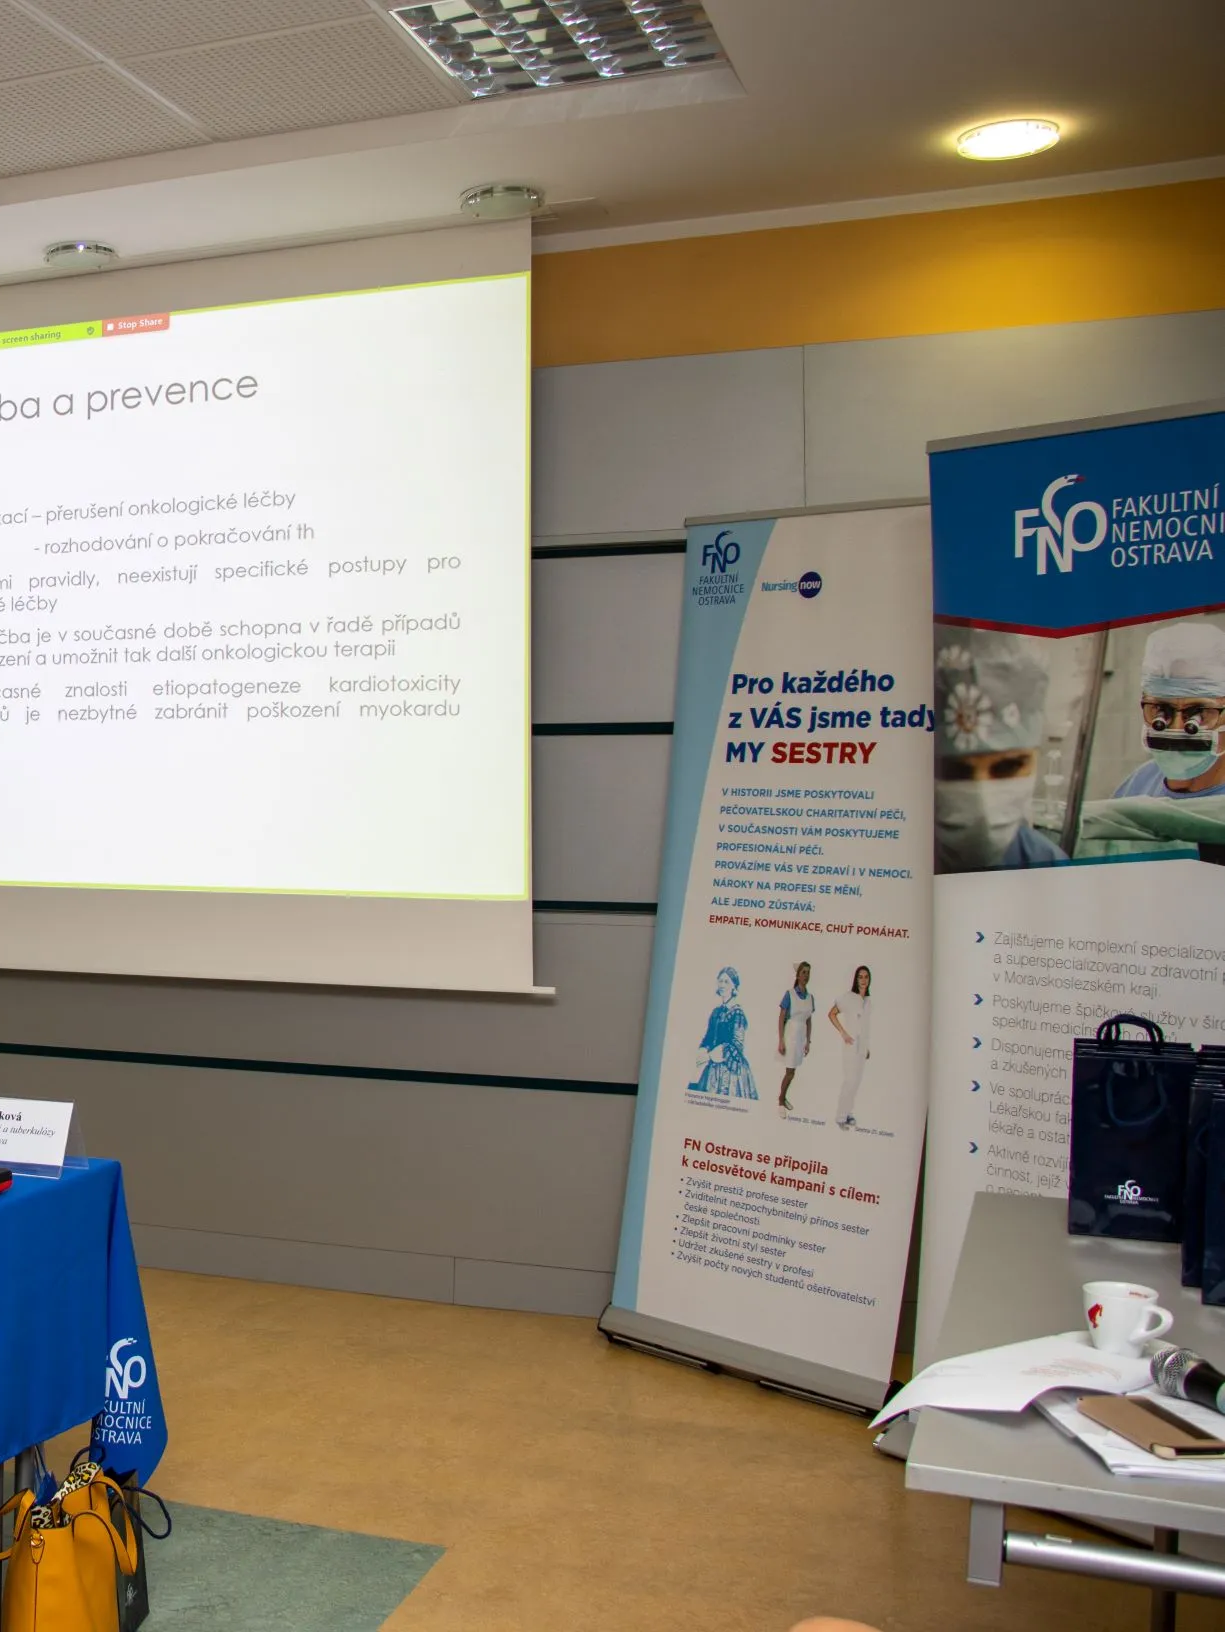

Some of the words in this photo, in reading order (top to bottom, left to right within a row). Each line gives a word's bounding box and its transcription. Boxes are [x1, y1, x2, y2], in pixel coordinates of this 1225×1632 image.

[117, 320, 138, 330] Stop
[138, 318, 163, 327] Share
[0, 334, 29, 345] screen
[29, 329, 62, 341] sharing
[52, 393, 74, 416] a
[86, 375, 259, 420] prevence
[45, 500, 125, 525] přerušení
[127, 493, 238, 516] onkologické
[242, 489, 296, 510] léčby
[1112, 482, 1220, 519] FAKULTNÍ
[43, 532, 154, 554] rozhodování
[156, 535, 169, 548] o
[173, 523, 293, 550] pokračování
[296, 522, 315, 540] th
[1111, 512, 1225, 543] NEMOCNI
[1110, 539, 1214, 568] OSTRAVA
[28, 569, 100, 592] pravidly,
[117, 563, 199, 584] neexistují
[214, 558, 309, 582] specifické
[327, 555, 408, 578] postupy
[426, 555, 462, 574] pro
[698, 571, 739, 585] FAKULTNÍ
[692, 583, 745, 596] NEMOCNICE
[761, 579, 798, 593] Nursing
[799, 580, 822, 590] now
[10, 594, 58, 613] léčby
[698, 594, 736, 606] OSTRAVA
[35, 627, 52, 647] je
[57, 629, 68, 643] v
[72, 623, 157, 642] současné
[162, 620, 213, 639] době
[219, 619, 302, 639] schopna
[308, 620, 320, 633] v
[326, 614, 374, 633] řadě
[381, 611, 461, 635] případů
[34, 653, 47, 666] a
[51, 647, 119, 665] umožnit
[123, 646, 151, 663] tak
[155, 644, 198, 662] další
[200, 641, 328, 663] onkologickou
[332, 638, 396, 660] terapii
[64, 680, 128, 698] znalosti
[151, 678, 302, 699] etiopatogeneze
[328, 673, 461, 695] kardiotoxicity
[731, 673, 775, 695] Pro
[780, 668, 896, 694] každého
[24, 705, 41, 726] je
[57, 703, 138, 724] nezbytné
[154, 701, 229, 720] zabránit
[246, 700, 342, 722] poškození
[359, 699, 460, 720] myokardu
[727, 711, 743, 729] z
[749, 701, 803, 729] VÁS
[806, 705, 872, 733] jsme
[725, 741, 766, 763] MY
[769, 741, 878, 764] SESTRY
[721, 787, 729, 796] V
[730, 787, 773, 797] HISTORII
[774, 788, 802, 799] JSME
[803, 789, 875, 800] POSKYTOVALI
[719, 804, 804, 817] PEČOVATELSKOU
[805, 807, 878, 819] CHARITATIVNÍ
[717, 823, 726, 833] V
[726, 822, 799, 836] SOUČASNOSTI
[800, 826, 823, 837] VÁM
[823, 827, 900, 839] POSKYTUJEME
[715, 841, 797, 854] PROFESIONÁLNÍ
[714, 859, 772, 872] PROVÁZÍME
[773, 862, 794, 873] VÁS
[795, 864, 810, 874] VE
[810, 864, 850, 876] ZDRAVÍ
[851, 866, 856, 876] I
[858, 867, 866, 877] V
[712, 878, 755, 889] NÁROKY
[755, 880, 772, 891] NA
[773, 881, 817, 893] PROFESI
[817, 883, 832, 895] SE
[710, 895, 730, 906] ALE
[731, 897, 766, 909] JEDNO
[825, 922, 855, 934] CHUŤ
[683, 1137, 702, 1152] FN
[704, 1141, 754, 1161] Ostrava
[755, 1152, 771, 1165] se
[773, 1154, 829, 1175] připojila
[681, 1154, 689, 1168] k
[691, 1159, 767, 1182] celosvětové
[769, 1171, 826, 1194] kampani
[827, 1185, 836, 1196] s
[838, 1185, 880, 1205] cílem:
